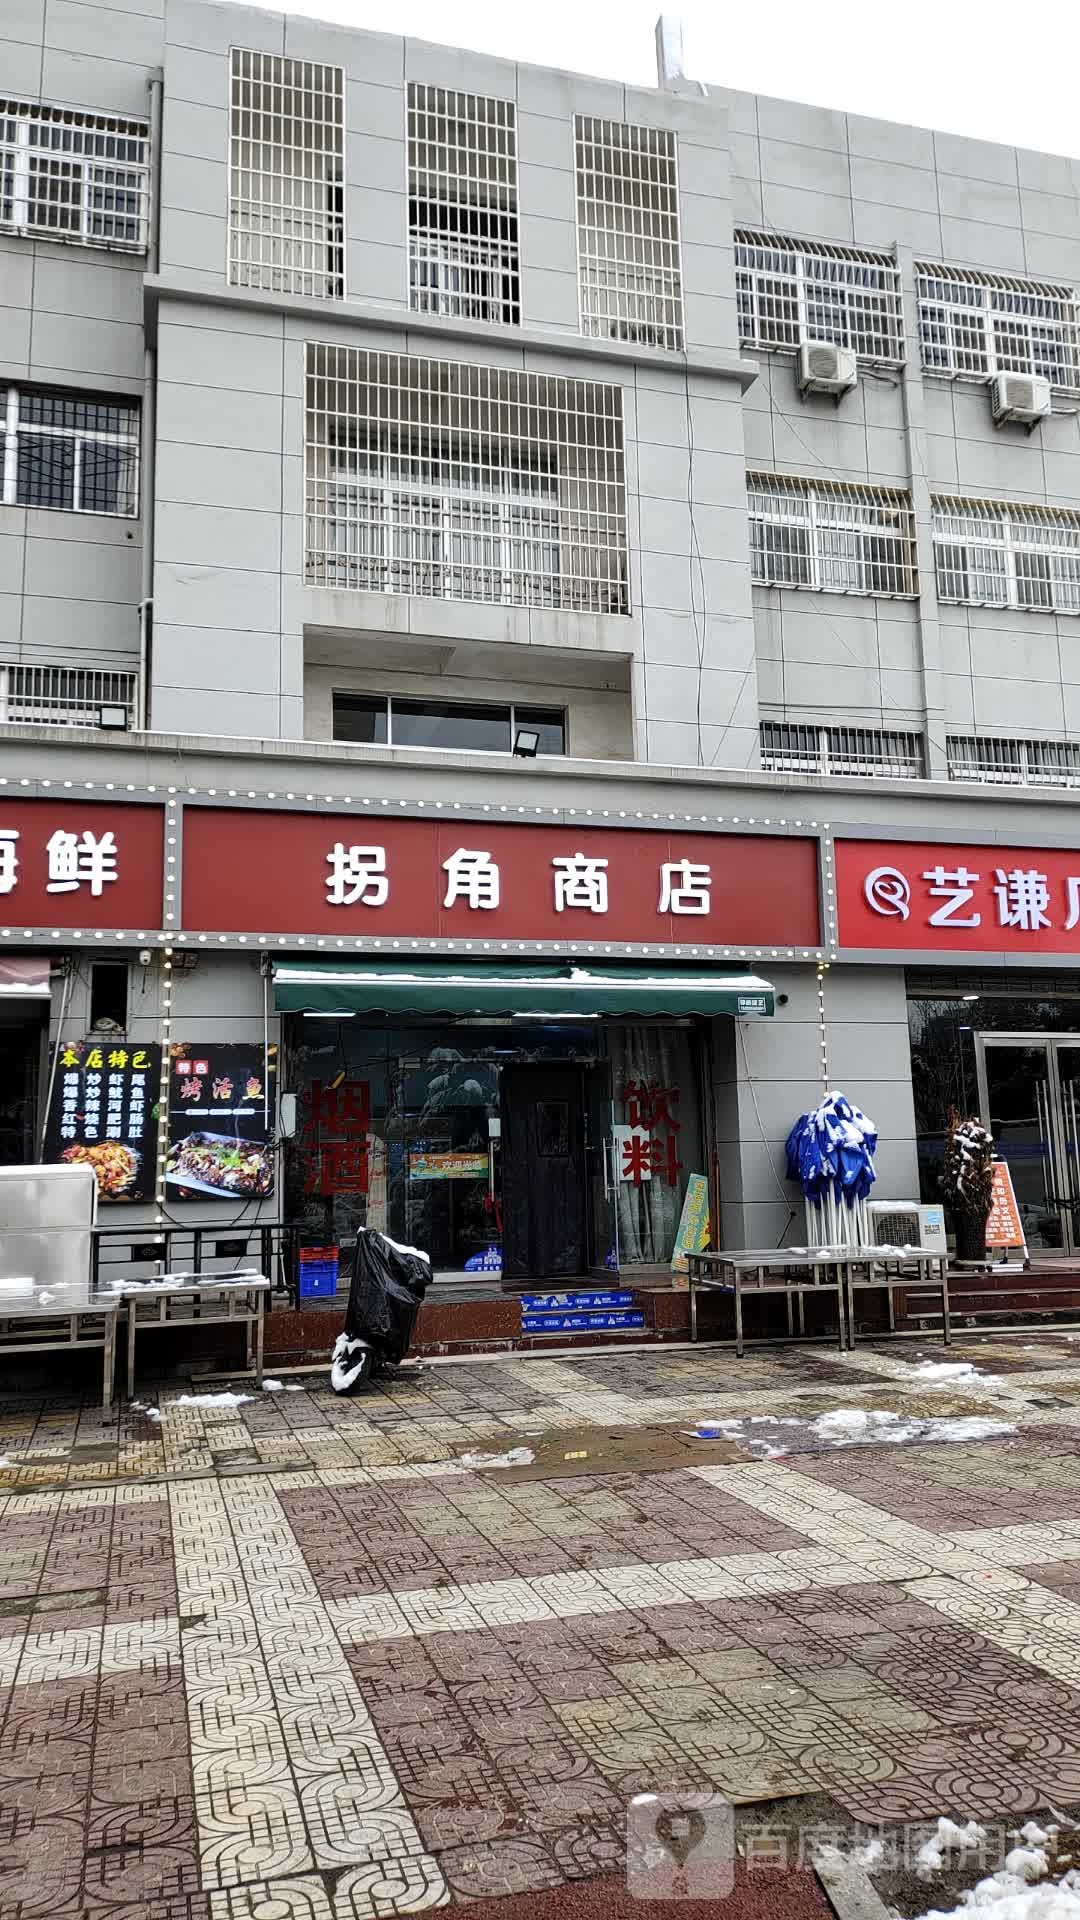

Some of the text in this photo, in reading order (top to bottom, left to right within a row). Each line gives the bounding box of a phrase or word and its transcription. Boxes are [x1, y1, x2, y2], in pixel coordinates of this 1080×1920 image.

[325, 842, 712, 914] 拐角商店
[922, 865, 1080, 930] 艺谦
[60, 1048, 151, 1068] 本店特色
[180, 1076, 265, 1101] 烤活鱼
[62, 1099, 144, 1112] 香辣河虾
[61, 1112, 144, 1125] 红烧肥肠
[619, 1079, 683, 1188] 饮料
